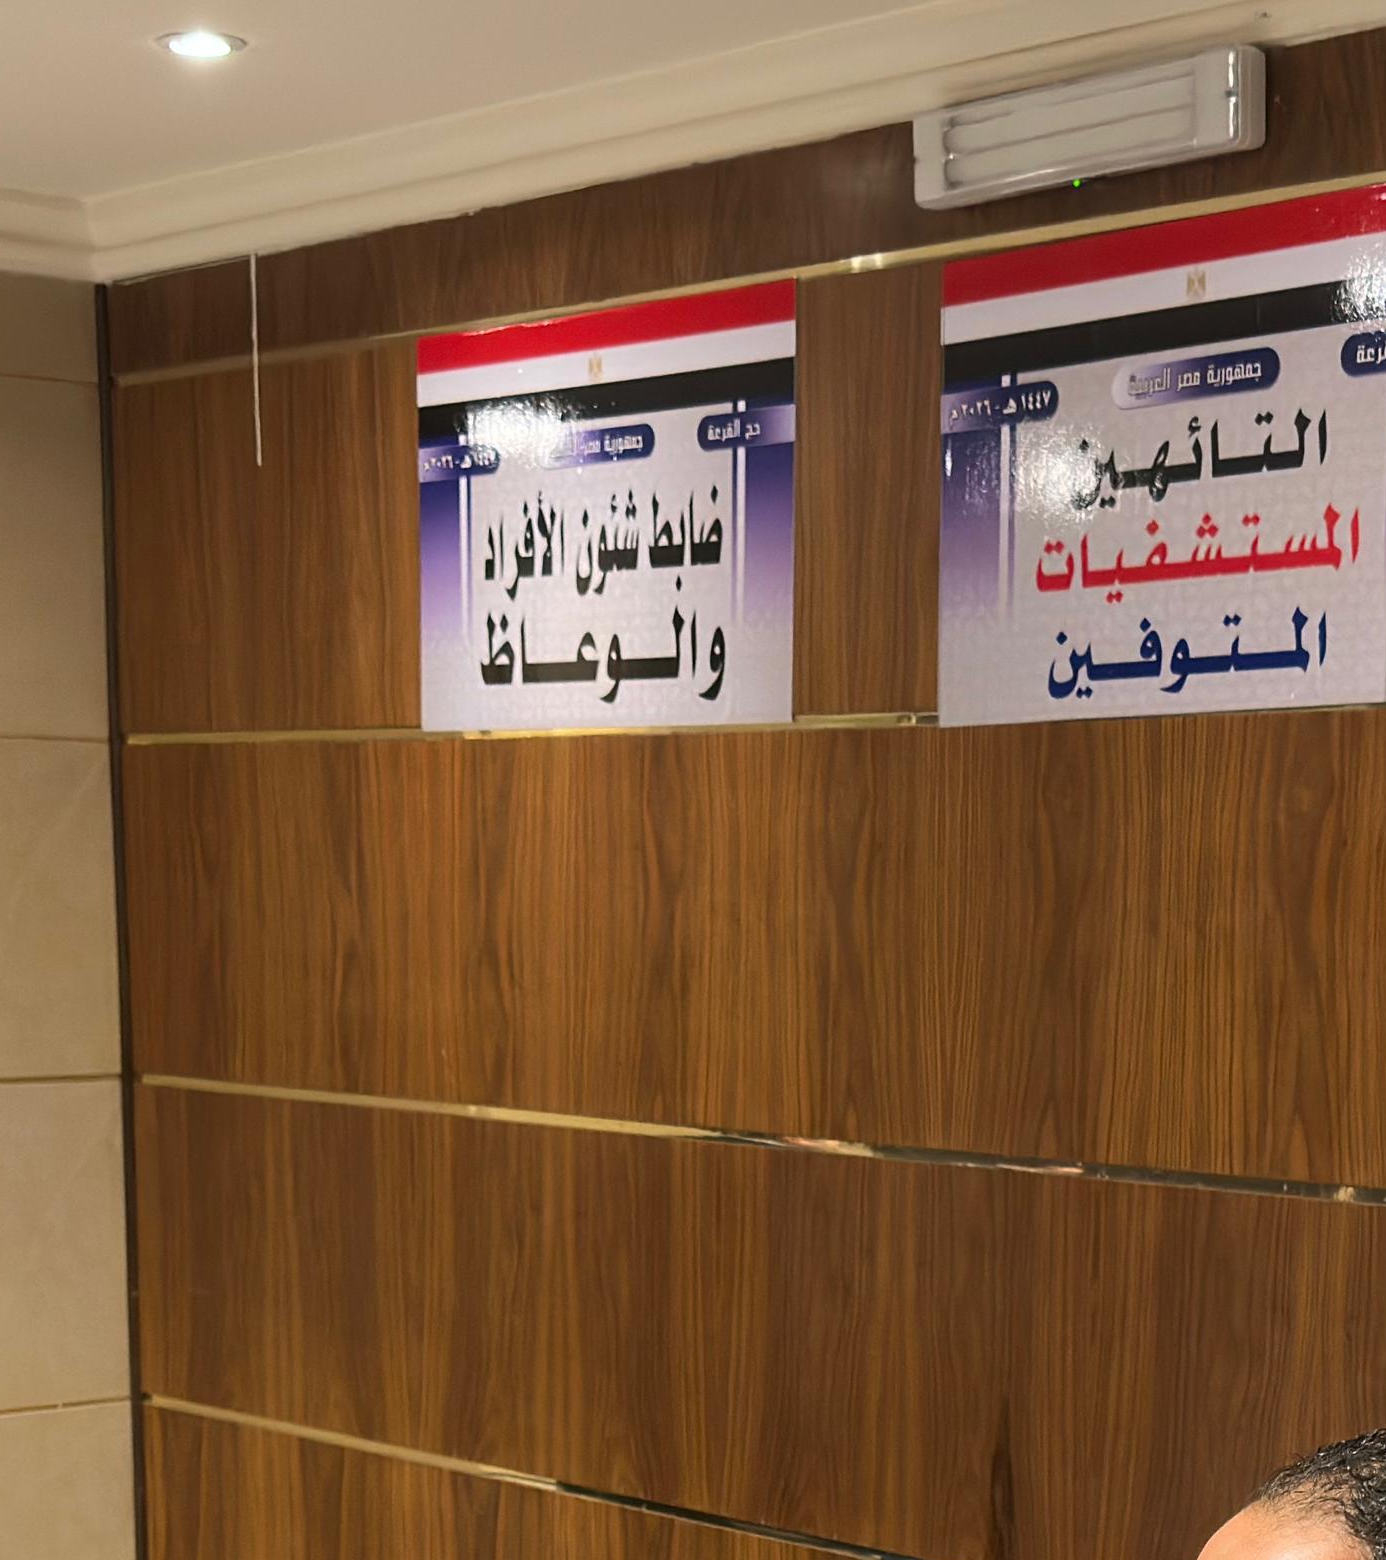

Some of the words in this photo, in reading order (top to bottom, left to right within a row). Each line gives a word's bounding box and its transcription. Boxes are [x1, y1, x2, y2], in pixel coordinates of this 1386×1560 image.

[1177, 371, 1200, 391] مصر
[1207, 362, 1261, 388] جمهورية
[1068, 408, 1328, 508] التائهين
[485, 490, 566, 600] الأفراد
[576, 489, 640, 596] شئون
[649, 485, 723, 591] ضابط
[1035, 502, 1360, 602] المستشفيات
[481, 605, 726, 703] والوعاظ
[1047, 606, 1327, 699] المتوفين
